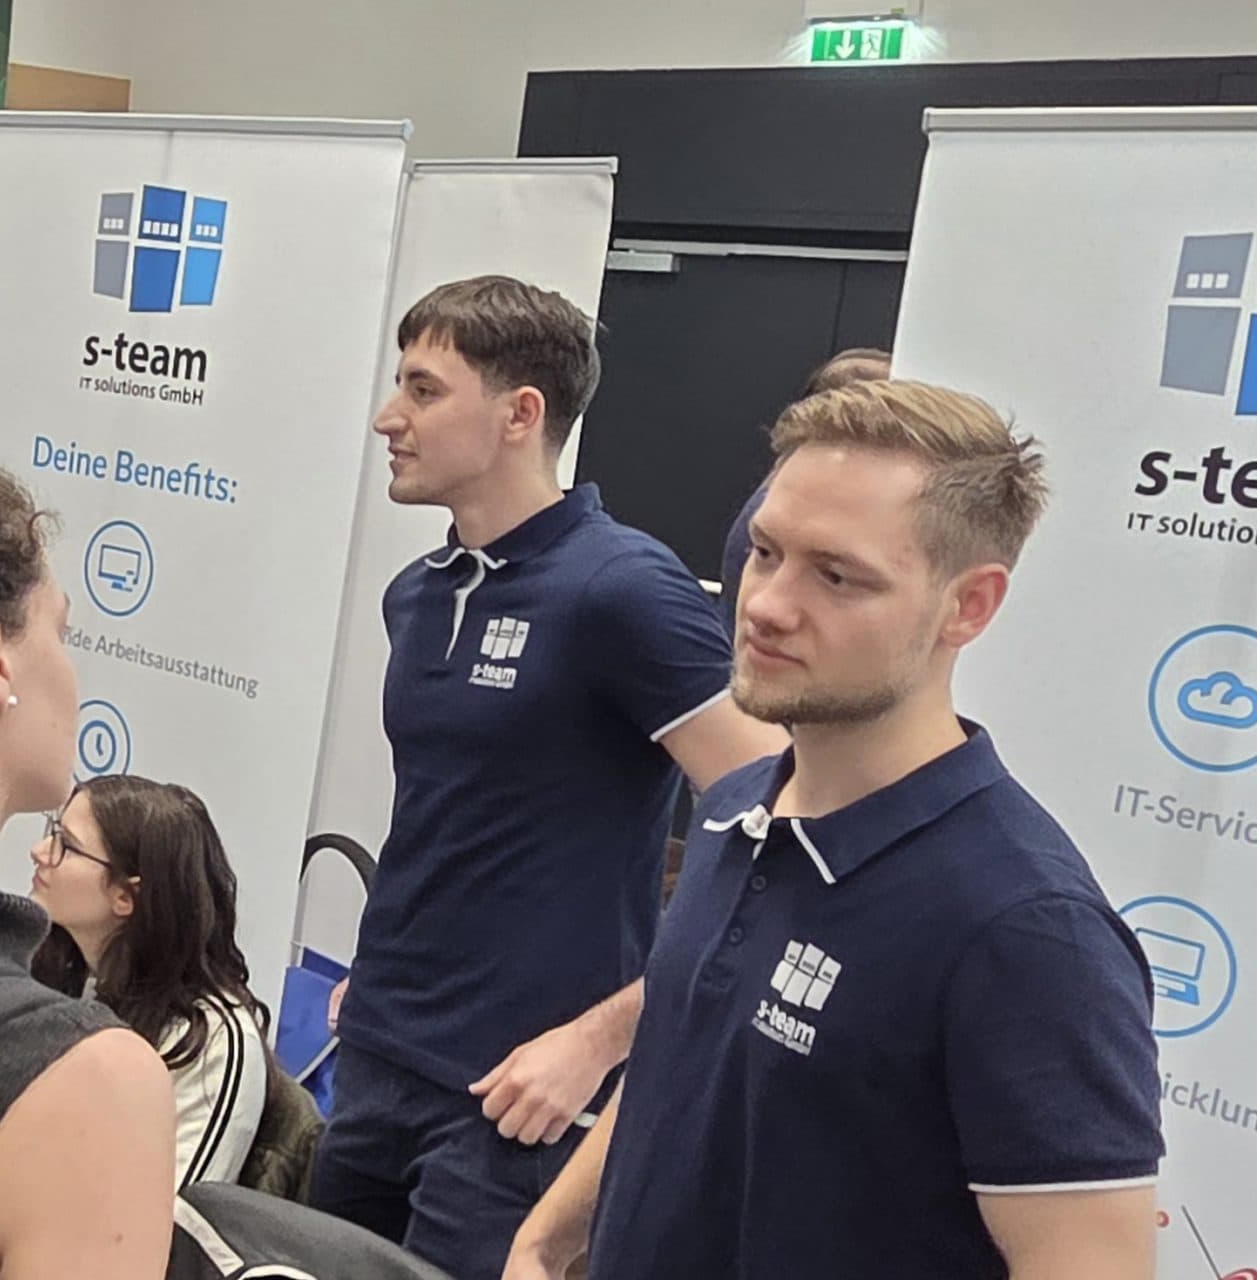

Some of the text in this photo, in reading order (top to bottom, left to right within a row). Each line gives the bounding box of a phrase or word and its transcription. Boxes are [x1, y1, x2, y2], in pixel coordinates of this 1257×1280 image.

[82, 332, 208, 382] s-team
[79, 376, 204, 406] IT solutions GmbH
[32, 435, 238, 504] Deine Benefits:
[1128, 512, 1257, 545] IT solutio
[95, 635, 259, 699] Arbeitsausstattung
[756, 999, 816, 1047] s-team
